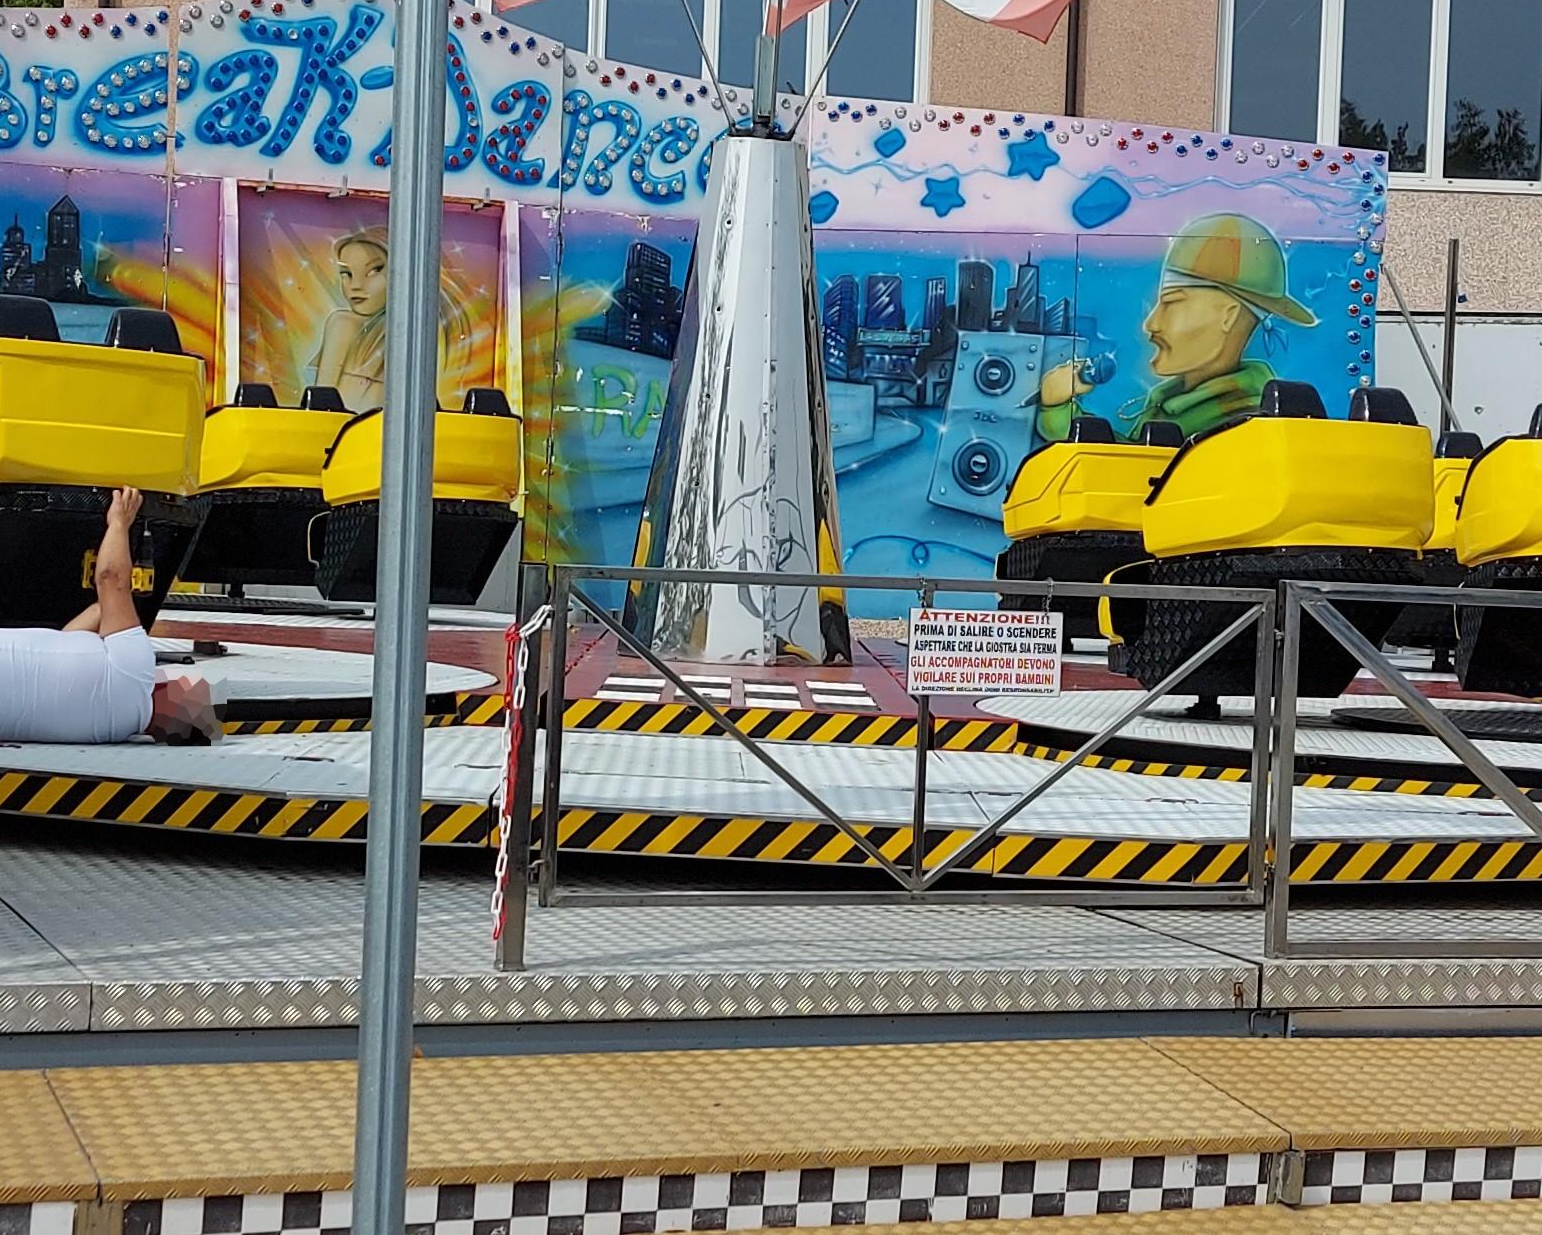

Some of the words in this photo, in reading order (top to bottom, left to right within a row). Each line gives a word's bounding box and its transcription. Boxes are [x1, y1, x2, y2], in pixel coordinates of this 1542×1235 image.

[914, 624, 944, 636] PRIMA
[948, 625, 957, 636] DI
[960, 625, 994, 637] SALIRE
[997, 627, 1004, 637] O
[1007, 627, 1057, 639] SCENDERE
[914, 640, 957, 652] ASPETTARE
[958, 641, 973, 652] CHE
[974, 641, 984, 652] LA
[986, 641, 1017, 653] GIOSTRA
[1020, 643, 1031, 653] SIA
[1033, 643, 1057, 654] FERMA
[911, 656, 926, 667] GLI
[929, 656, 1015, 669] ACCOMPAGNATORI
[1017, 659, 1055, 670] DEVONO
[914, 671, 957, 683] VIGILARE
[960, 672, 975, 683] SUI
[978, 673, 1013, 684] PROPRI
[1015, 674, 1054, 685] BAMBINI
